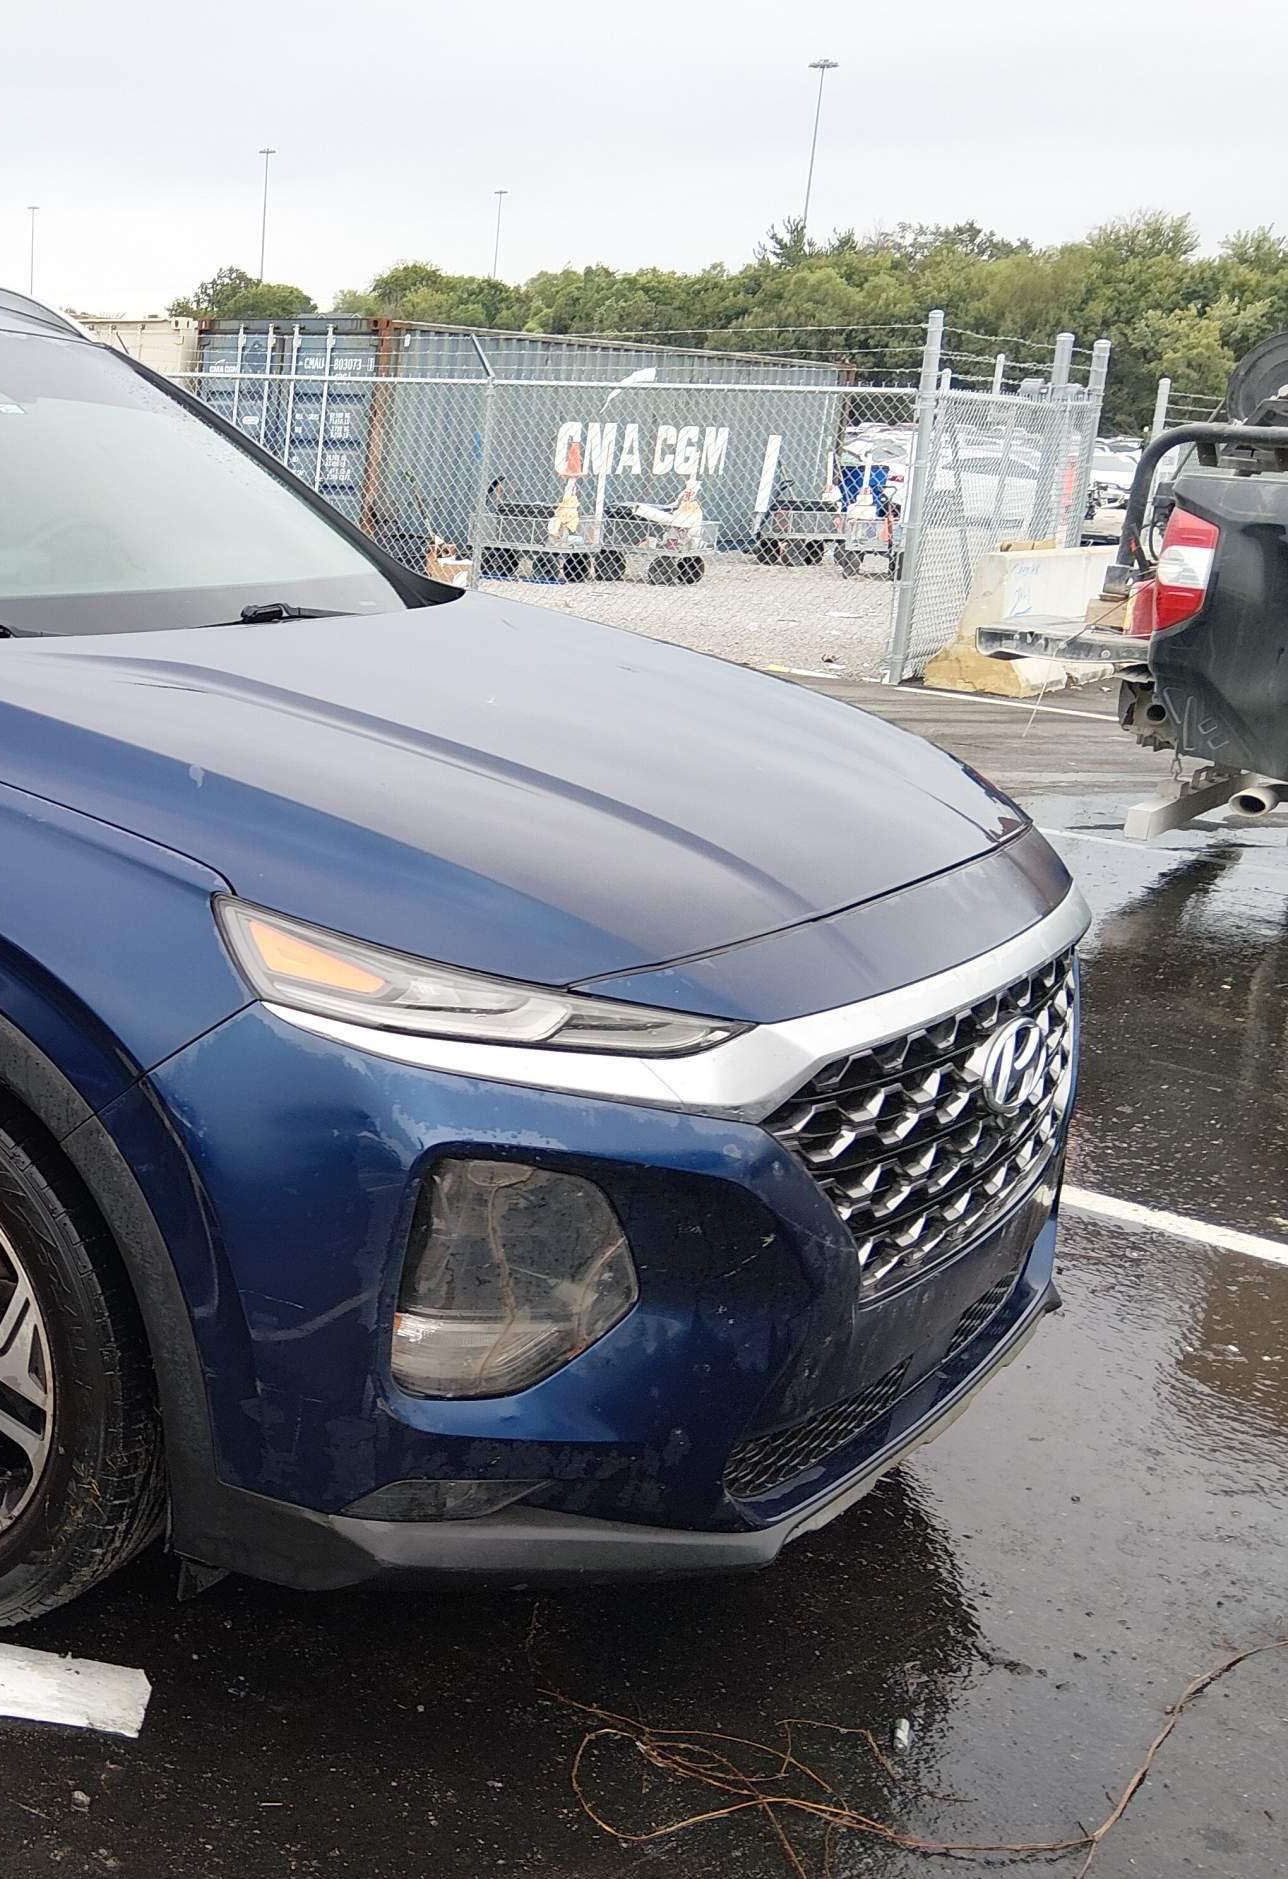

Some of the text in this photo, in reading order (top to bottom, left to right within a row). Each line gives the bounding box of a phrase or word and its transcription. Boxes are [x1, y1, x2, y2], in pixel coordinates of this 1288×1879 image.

[304, 357, 325, 369] CMAU
[333, 358, 362, 371] 803073
[554, 421, 730, 476] CMA CGM
